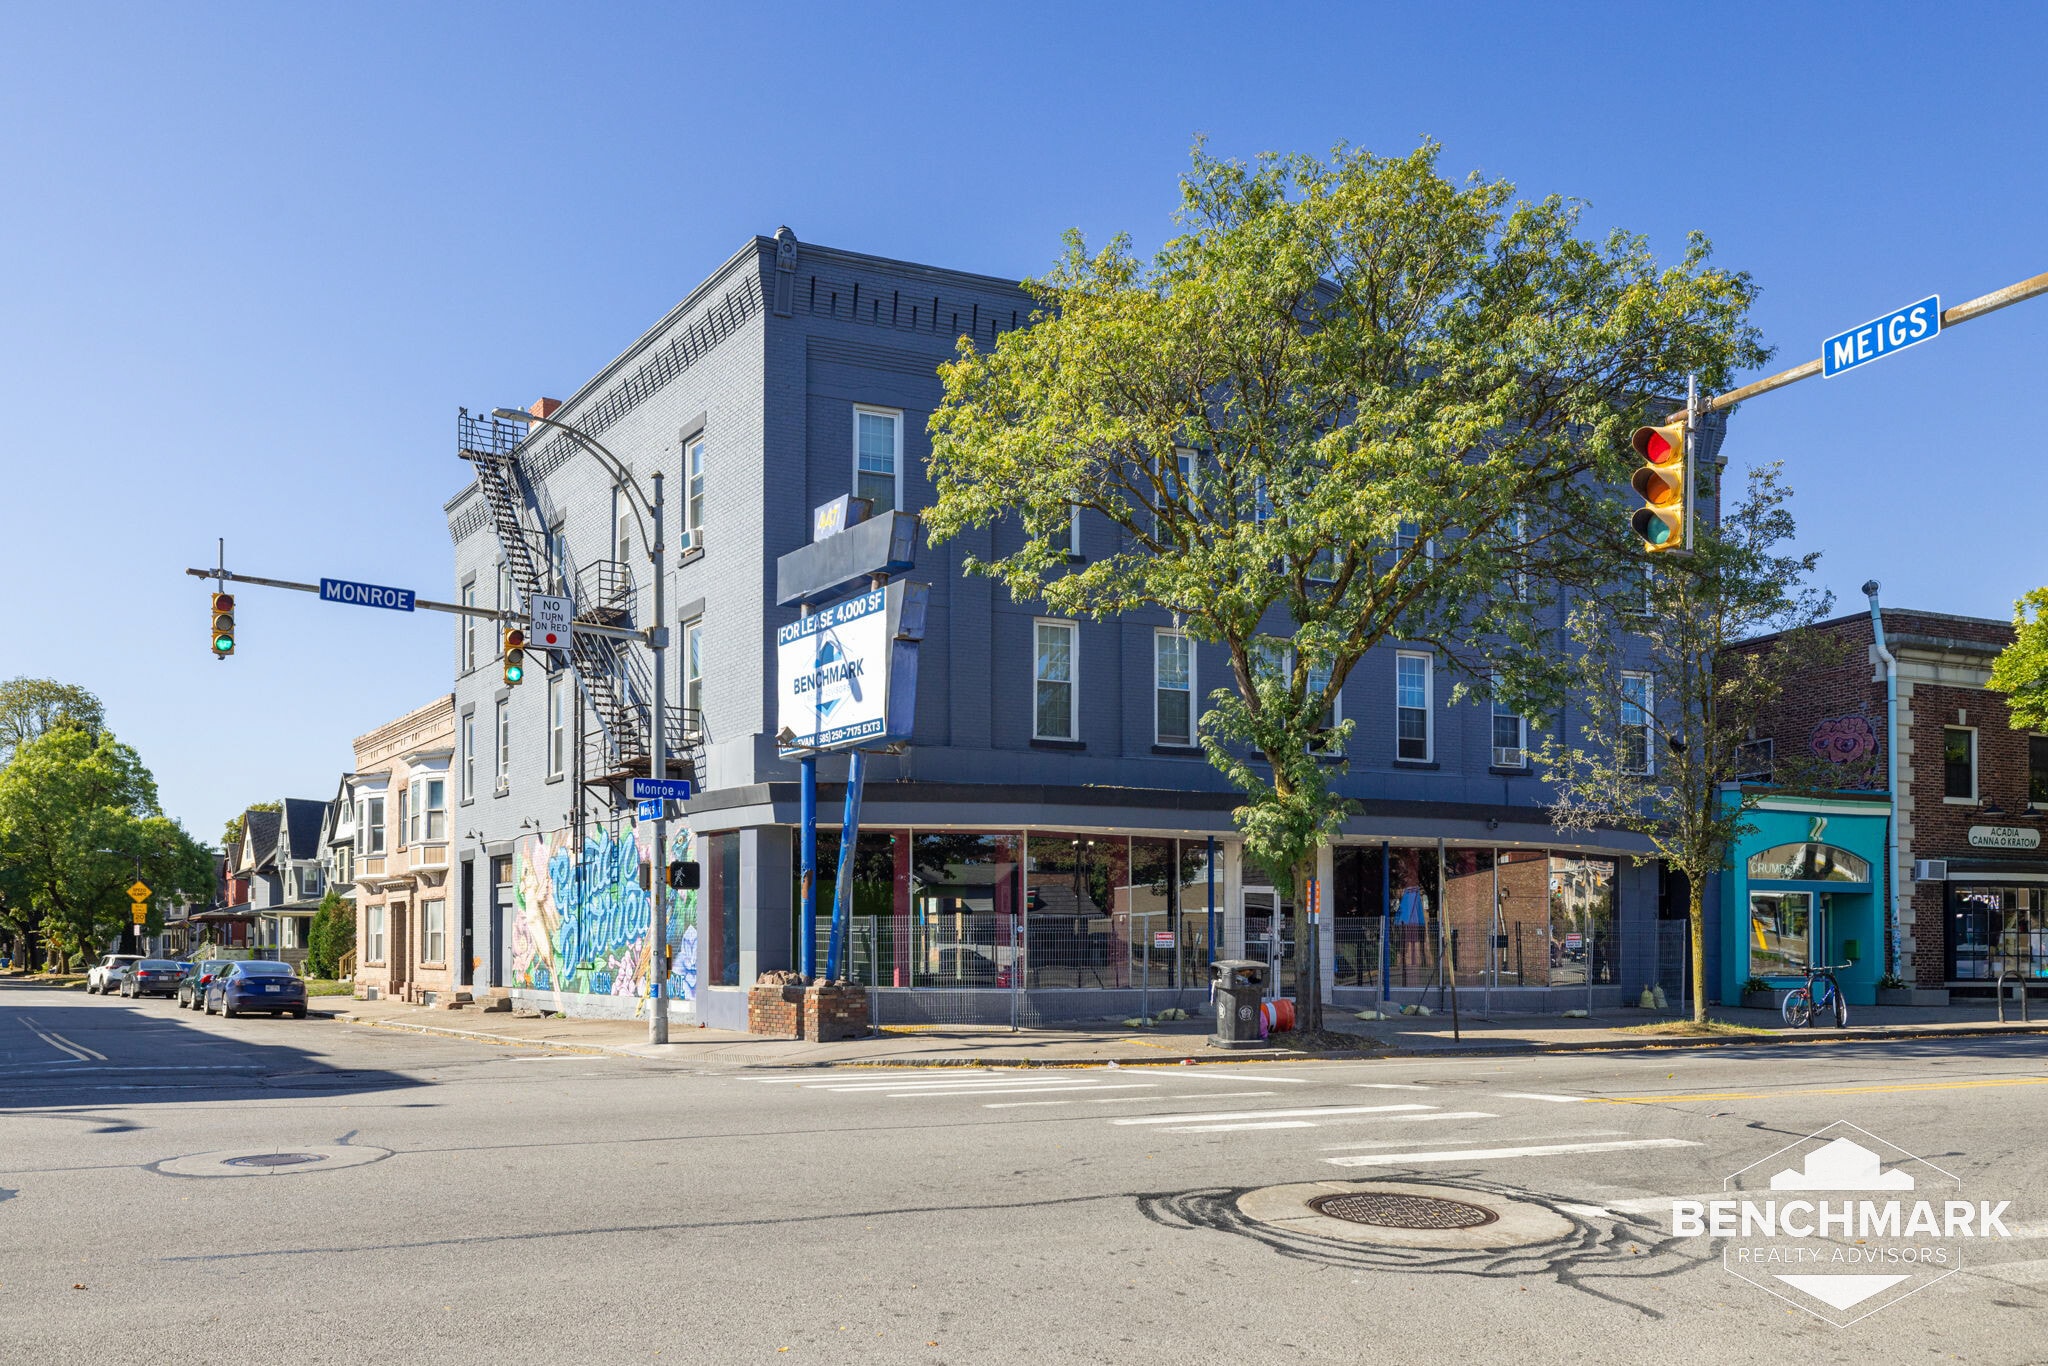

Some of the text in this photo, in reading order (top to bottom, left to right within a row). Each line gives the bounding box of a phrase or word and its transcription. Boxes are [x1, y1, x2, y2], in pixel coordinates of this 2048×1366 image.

[1834, 306, 1928, 370] MEIGS
[326, 581, 409, 609] MONROE
[543, 601, 560, 611] NO
[541, 612, 564, 622] TURN
[780, 592, 882, 643] FOR LEASE 4,000 SF
[535, 621, 568, 632] ON RED
[793, 657, 865, 695] BENCHMARK
[832, 725, 862, 740] 250-7175
[636, 782, 675, 796] Monroe
[1991, 827, 2020, 837] ACADIA
[1972, 836, 1999, 846] CANNA
[2007, 837, 2037, 847] KRATOM
